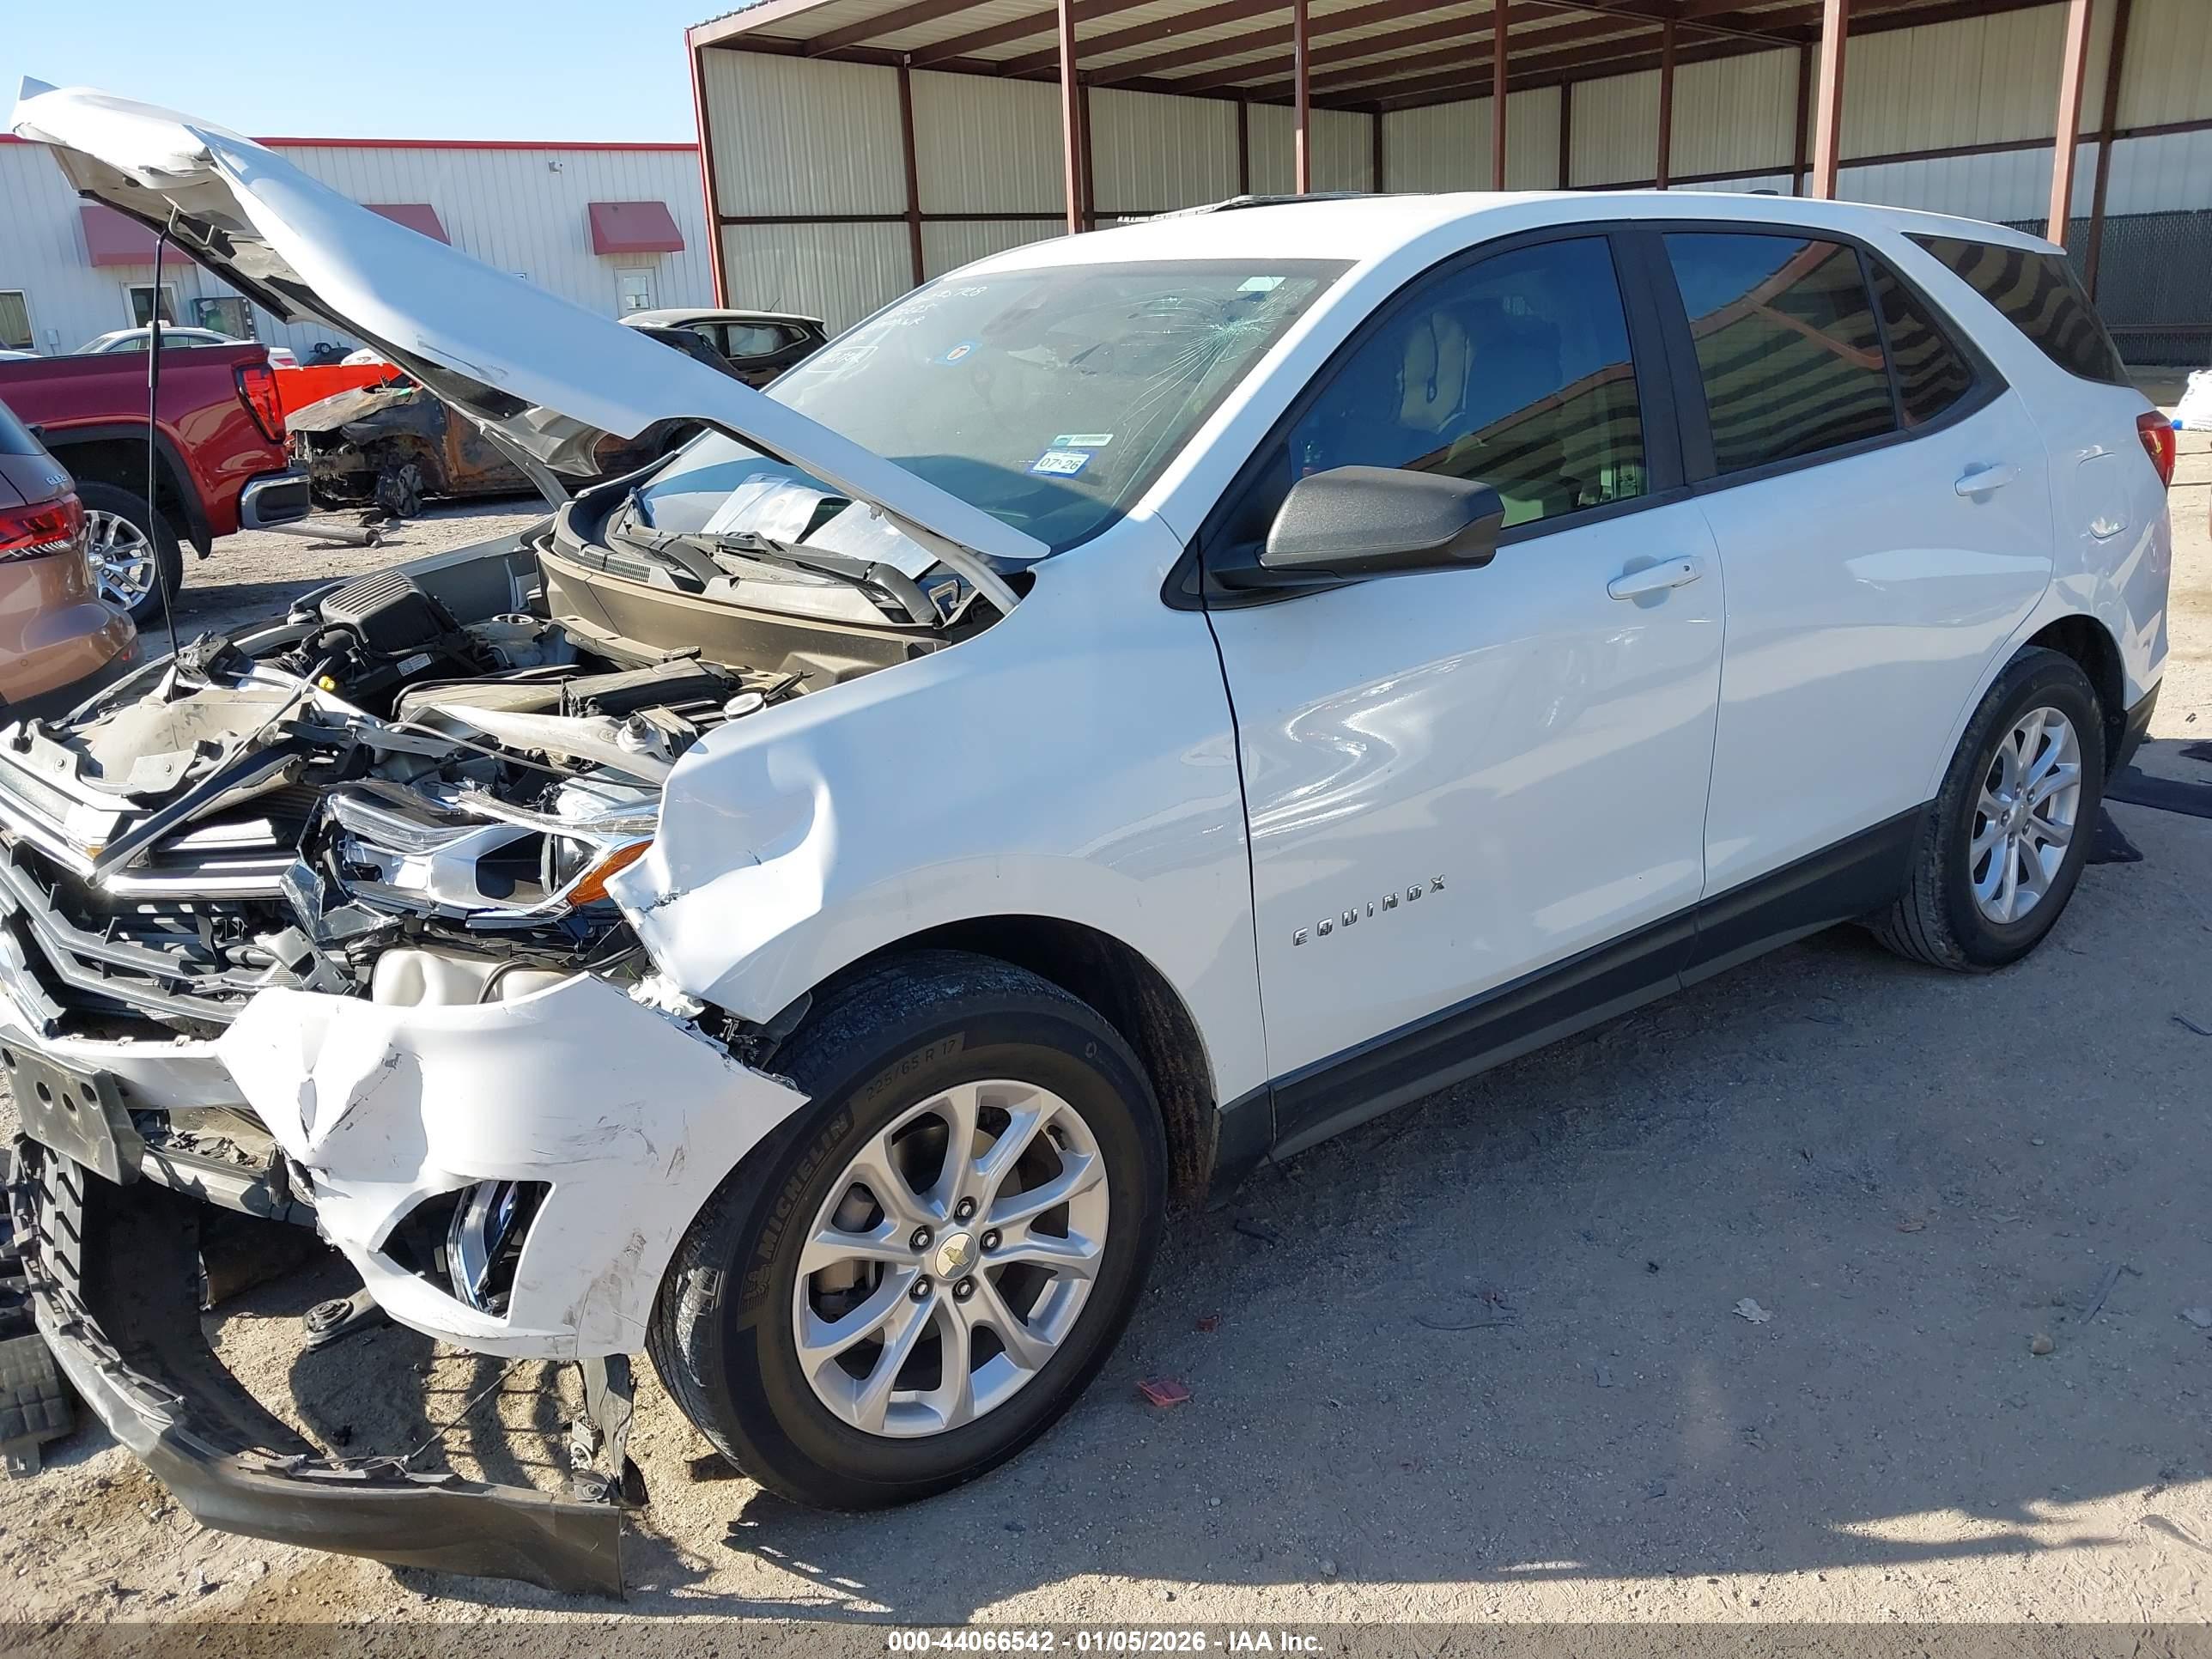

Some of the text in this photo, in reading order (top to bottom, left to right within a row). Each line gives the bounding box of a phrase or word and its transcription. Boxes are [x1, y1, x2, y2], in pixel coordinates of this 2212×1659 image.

[1292, 874, 1446, 946] EQUINOX
[866, 1039, 956, 1103] 225/65 R 17
[757, 1111, 851, 1260] MICHELIN
